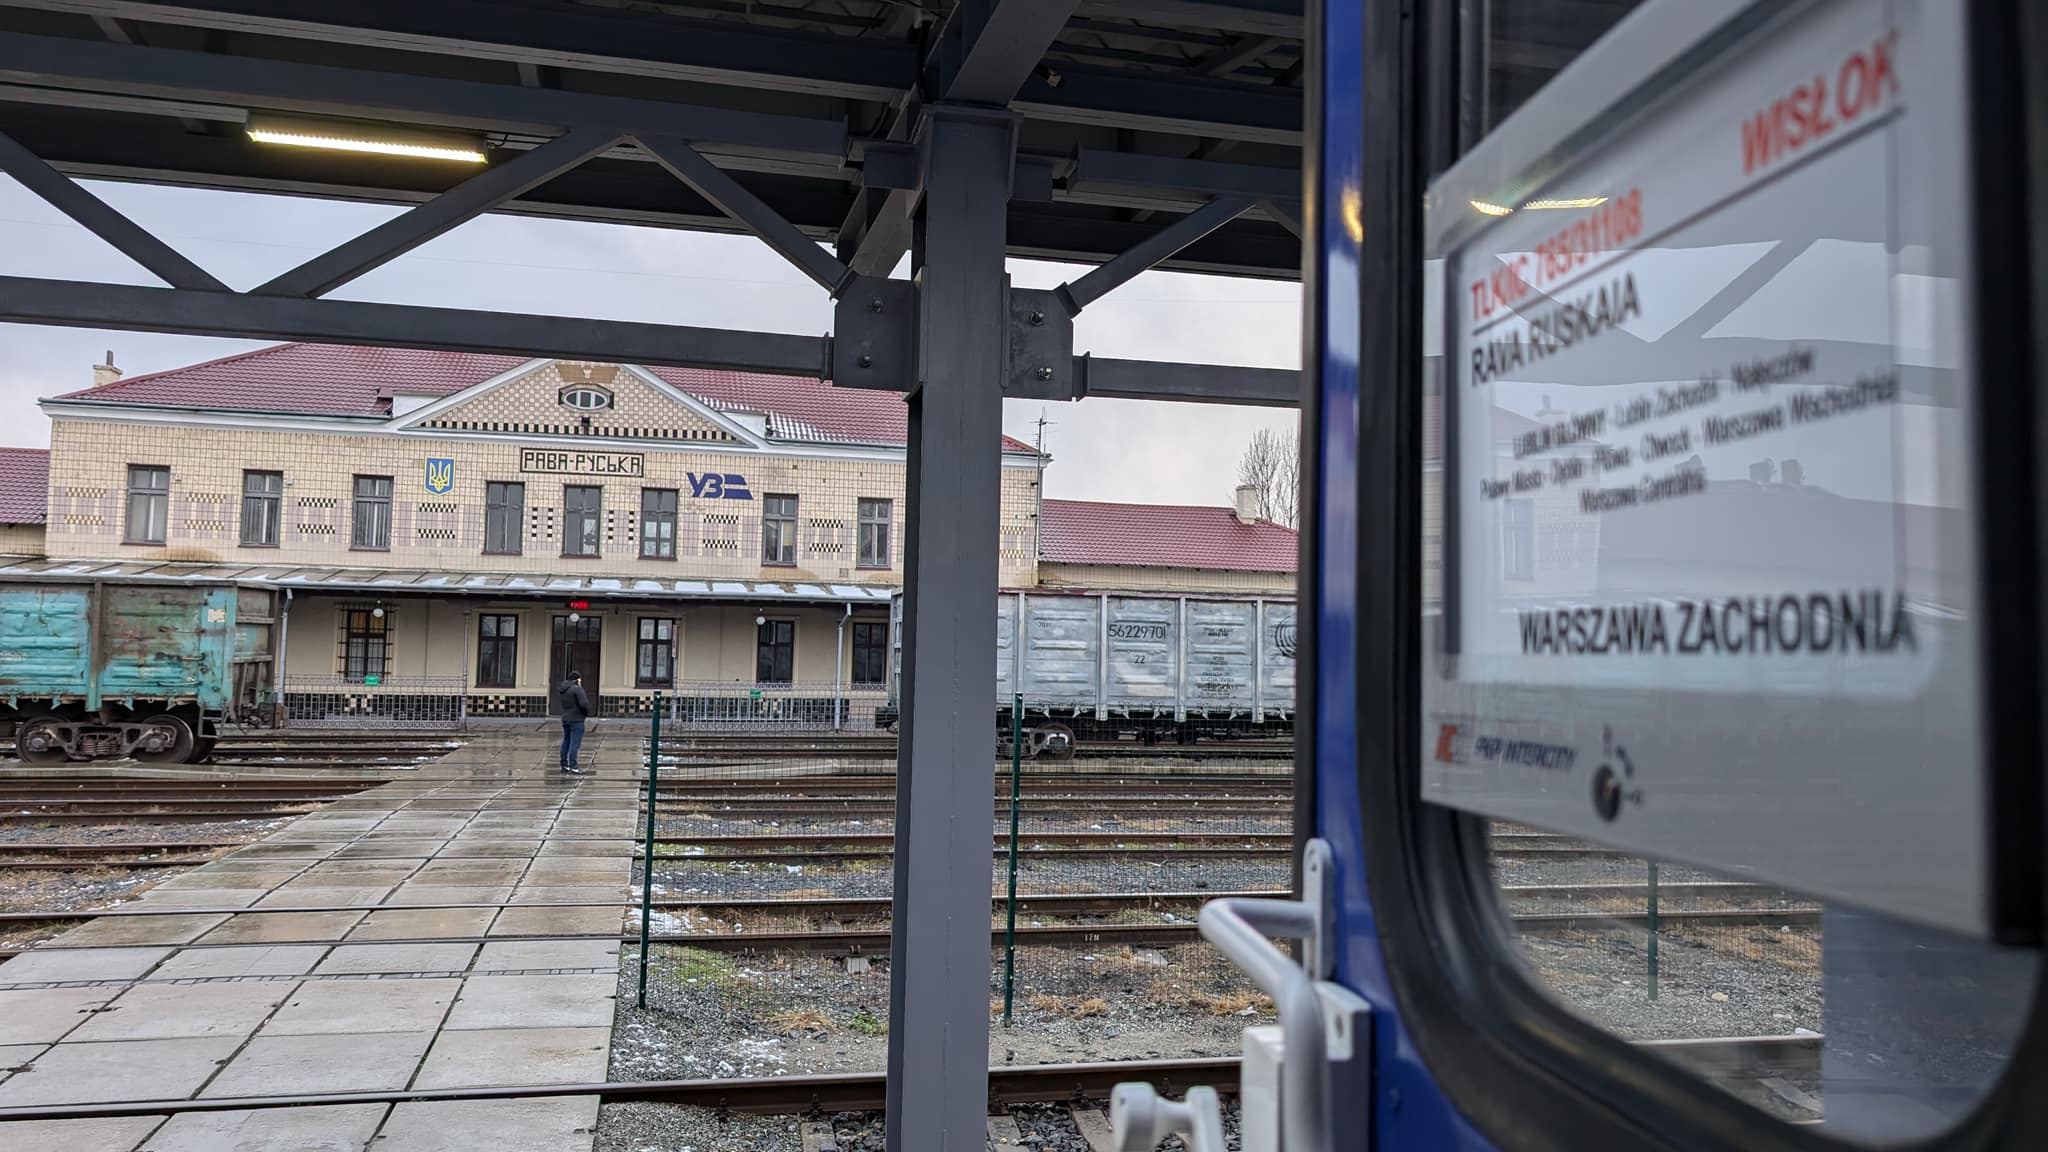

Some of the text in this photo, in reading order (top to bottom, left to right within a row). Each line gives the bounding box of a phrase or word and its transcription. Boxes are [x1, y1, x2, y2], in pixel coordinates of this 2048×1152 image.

[1742, 28, 1900, 175] WISŁOK
[1472, 272, 1642, 387] RAVA RUSKAIA
[1703, 401, 1786, 445] Warszawa
[523, 451, 641, 474] РАВА-РУСЬКА
[1108, 623, 1167, 639] 56229701
[1518, 590, 1918, 655] WARSZAWA ZACHODNIA
[1134, 655, 1146, 664] 22
[1475, 735, 1501, 760] PKP
